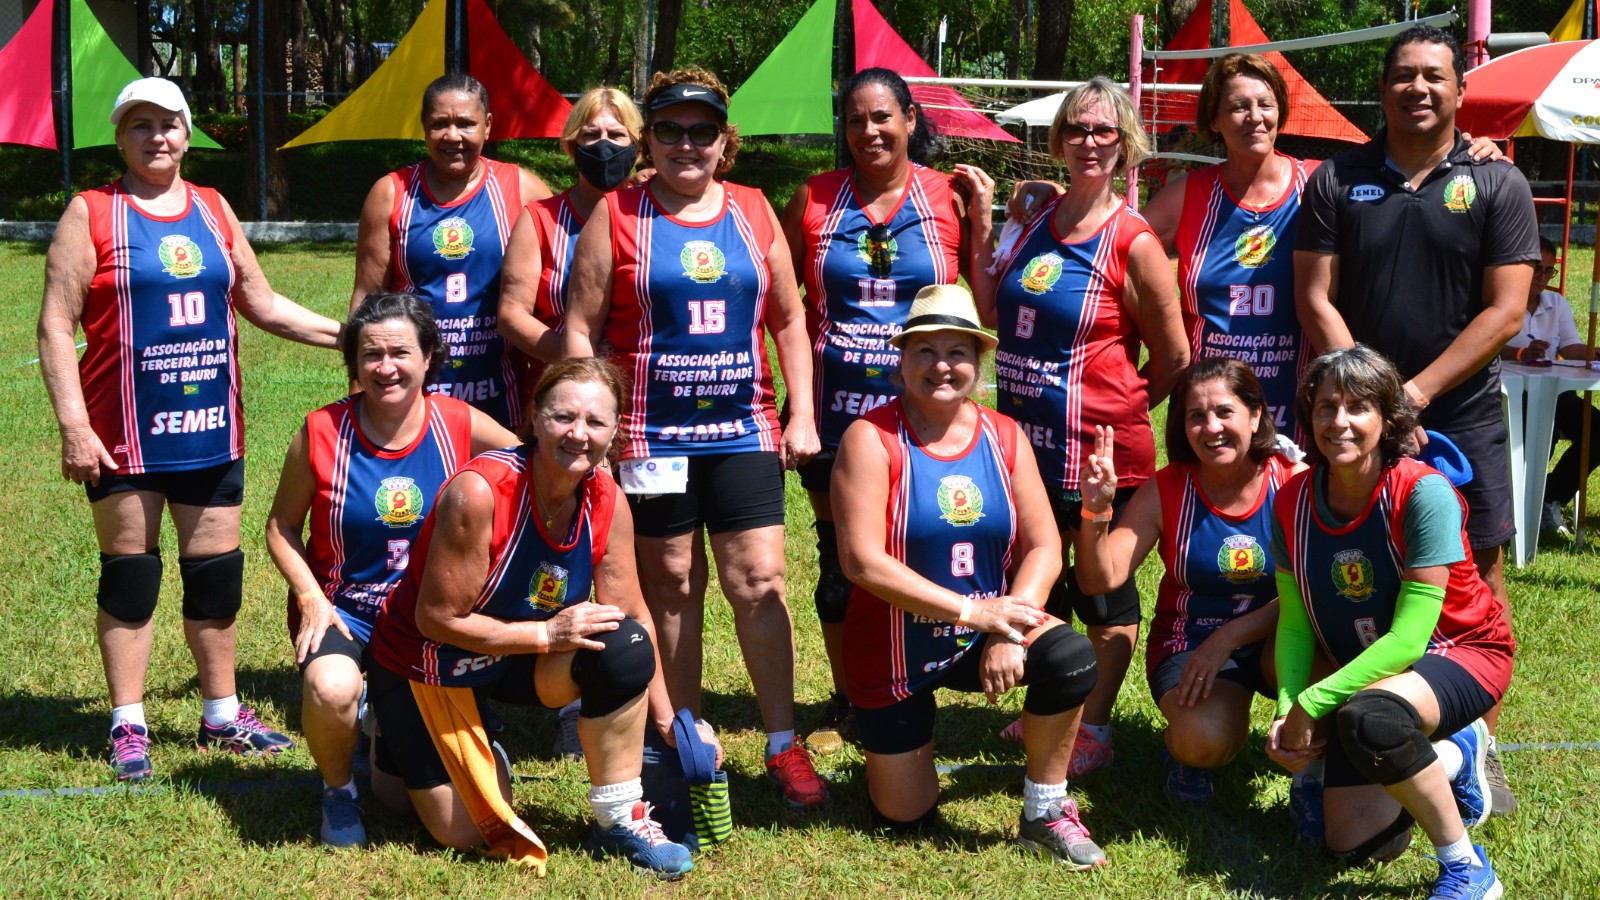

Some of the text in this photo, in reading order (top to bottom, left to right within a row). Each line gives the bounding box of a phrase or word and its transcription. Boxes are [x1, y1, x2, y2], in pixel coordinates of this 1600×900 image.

[446, 272, 467, 303] 9
[858, 278, 897, 307] 19
[168, 292, 206, 327] 10
[1229, 285, 1274, 316] 20
[435, 315, 481, 331] OCIAÇÃO
[688, 300, 726, 335] 15
[1015, 305, 1036, 339] 5
[143, 338, 214, 357] ASSOCIAÇÃO
[441, 332, 467, 344] EIRA
[1206, 332, 1294, 350] ASSOCIAÇÃO DA
[201, 352, 227, 366] IDADE
[449, 344, 487, 357] BAURU
[657, 350, 750, 369] ASSOCIAÇÃO DA
[843, 351, 901, 367] DE BAUR
[1261, 350, 1296, 363] IDADE
[160, 368, 218, 384] DE BAURU
[720, 366, 753, 380] IDADE
[1043, 361, 1059, 372] DA
[1026, 372, 1061, 386] IDADE
[673, 383, 738, 397] DE BAURU
[1010, 382, 1043, 398] BAURU
[831, 390, 897, 416] SEM
[150, 405, 226, 435] SEMEL
[658, 419, 751, 441] SEMEL
[386, 539, 410, 570] 3
[951, 542, 975, 577] 8
[1232, 594, 1256, 614] 7
[933, 626, 951, 637] DE
[1354, 617, 1379, 649] 6
